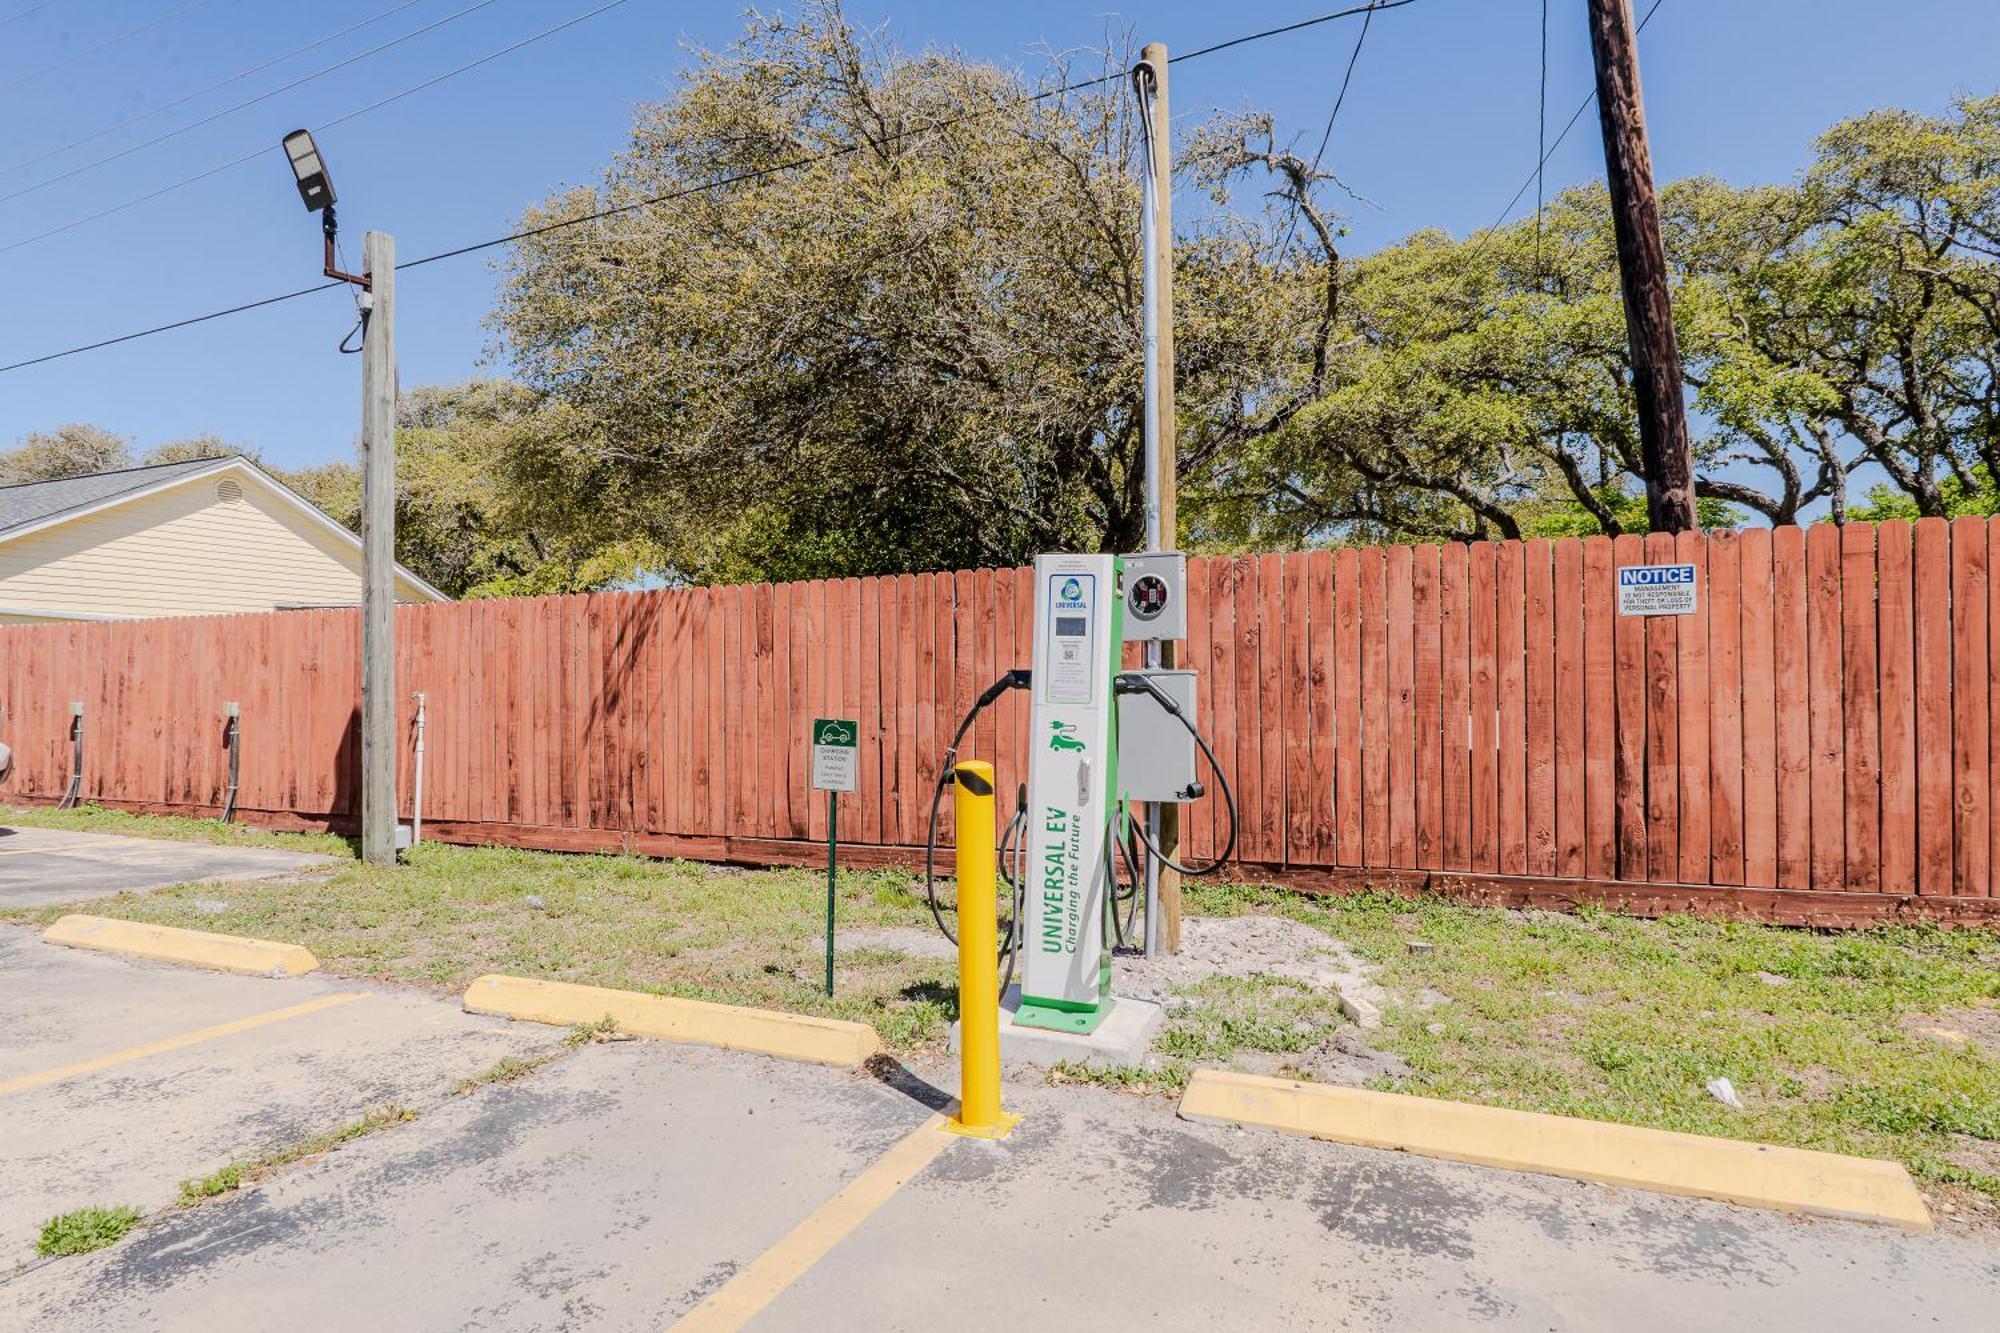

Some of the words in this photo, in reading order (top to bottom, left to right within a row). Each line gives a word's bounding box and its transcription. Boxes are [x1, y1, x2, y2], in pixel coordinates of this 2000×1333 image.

[1623, 568, 1691, 584] NOTICE
[1046, 806, 1067, 833] EV
[1068, 814, 1081, 859] Future
[1067, 864, 1078, 886] the
[1042, 841, 1066, 953] UNIVERSAL
[1065, 890, 1081, 954] Charging
